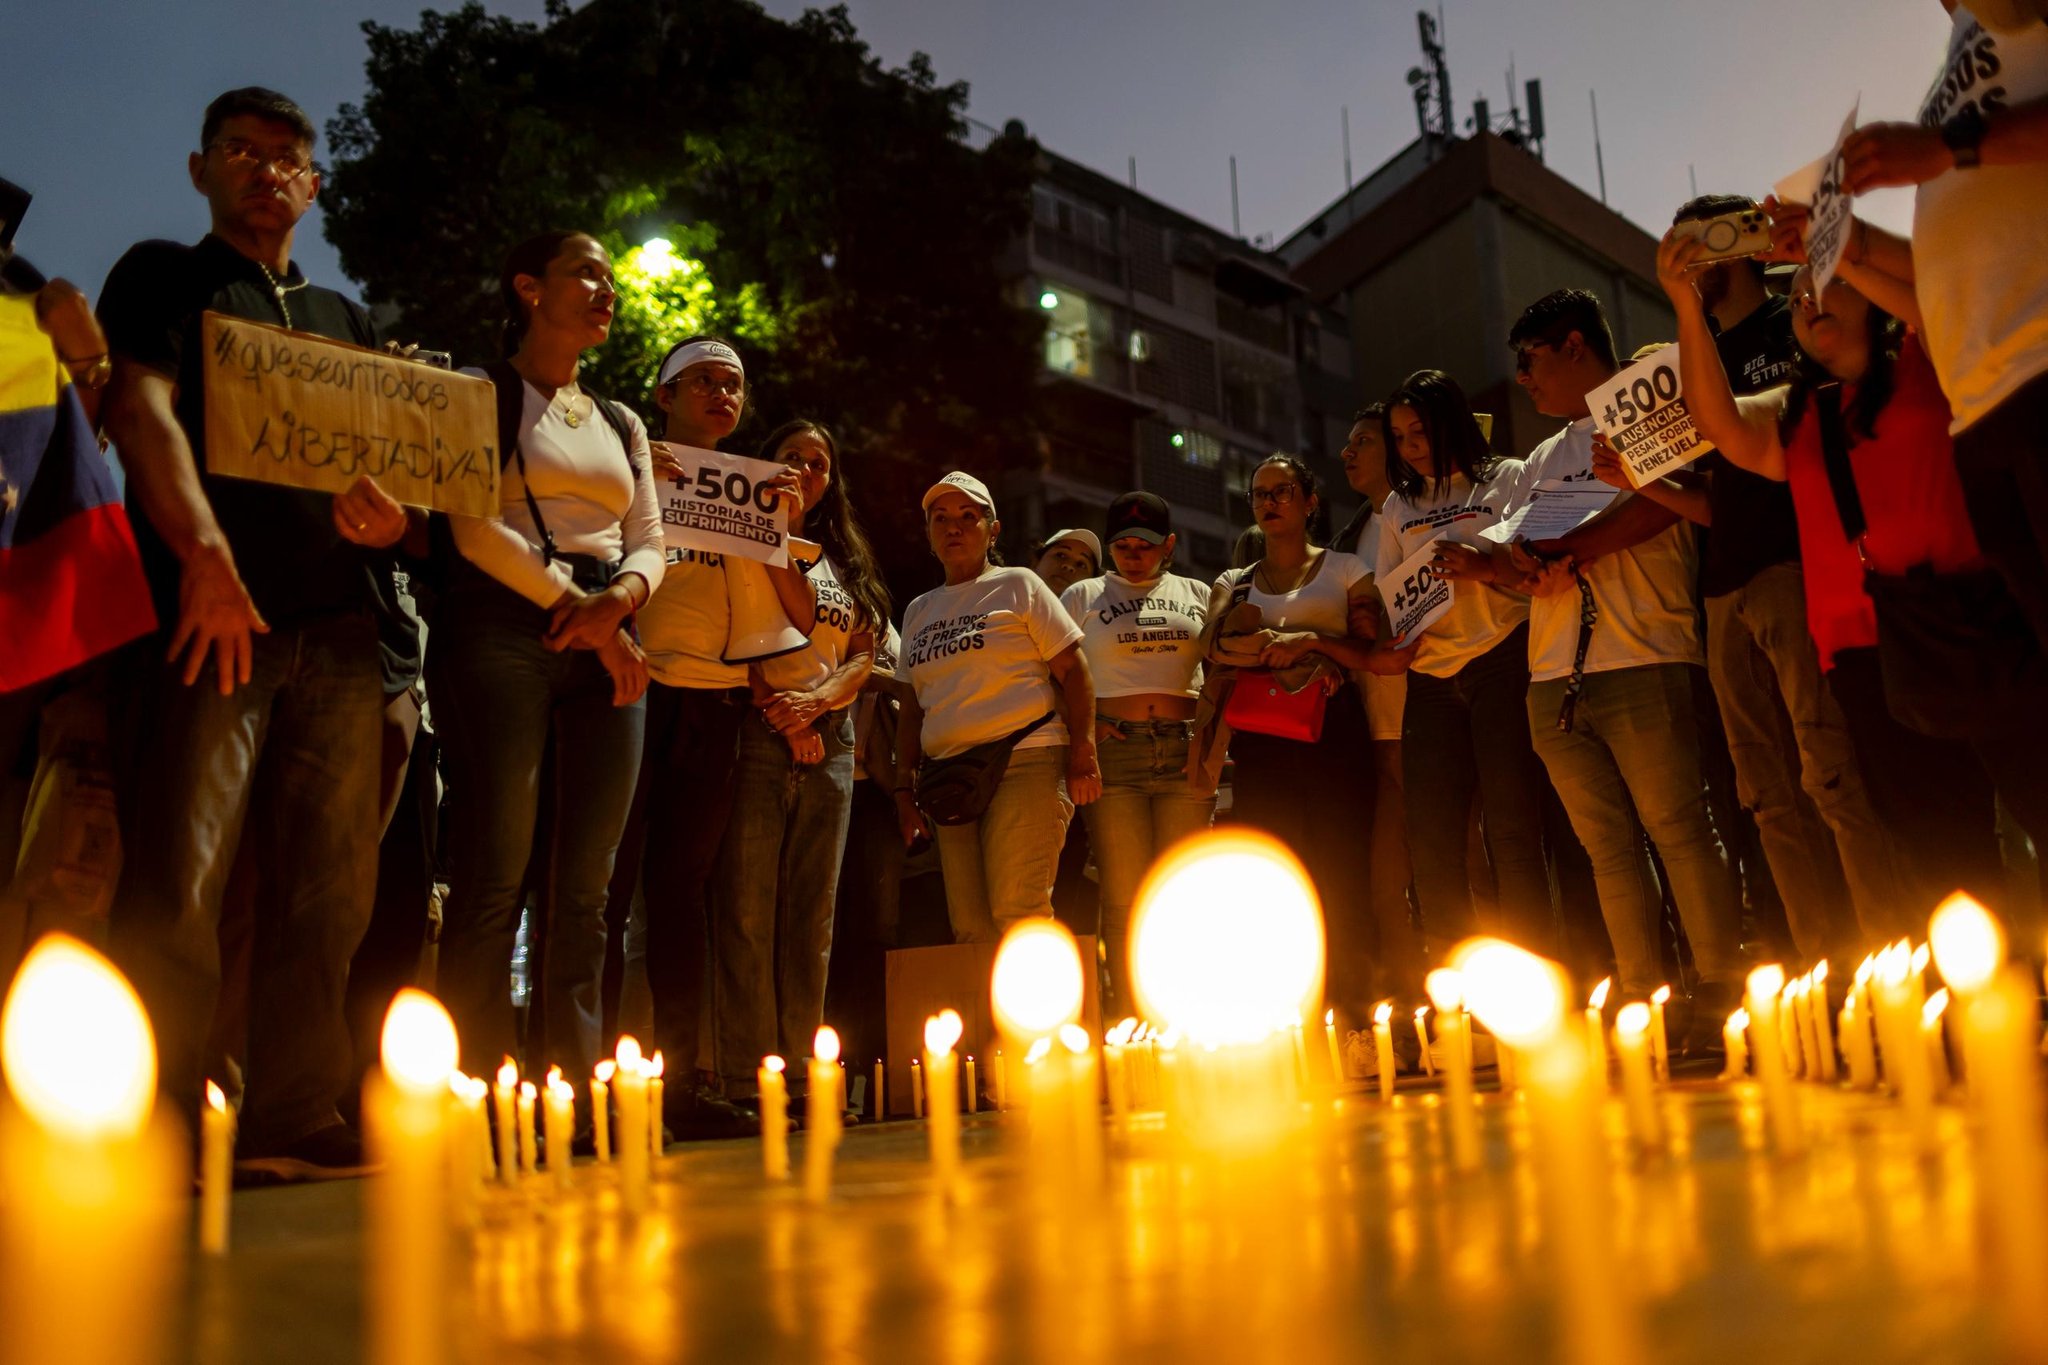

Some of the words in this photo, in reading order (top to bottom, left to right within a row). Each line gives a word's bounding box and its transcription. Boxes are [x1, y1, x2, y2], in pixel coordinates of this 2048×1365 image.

[1743, 354, 1766, 375] BIG
[1602, 365, 1677, 428] +500
[1620, 402, 1686, 447] AUSENCIAS
[1626, 437, 1660, 461] PESAN
[1659, 417, 1695, 444] SOBRE
[1633, 431, 1703, 475] VENEZUELA
[668, 467, 780, 514] +500
[664, 510, 777, 544] SUFRIMIENTO
[670, 498, 752, 523] HISTORIAS
[756, 515, 775, 529] DE
[1401, 505, 1493, 533] VENEZOLANA
[812, 578, 850, 596] TOD
[1393, 553, 1446, 611] +500
[816, 590, 852, 610] SOS
[1099, 598, 1197, 625] CALIFORNIA
[816, 604, 850, 632] COS
[931, 621, 986, 644] PRESOS
[1117, 633, 1138, 643] LOS
[1142, 630, 1190, 641] ANGELES
